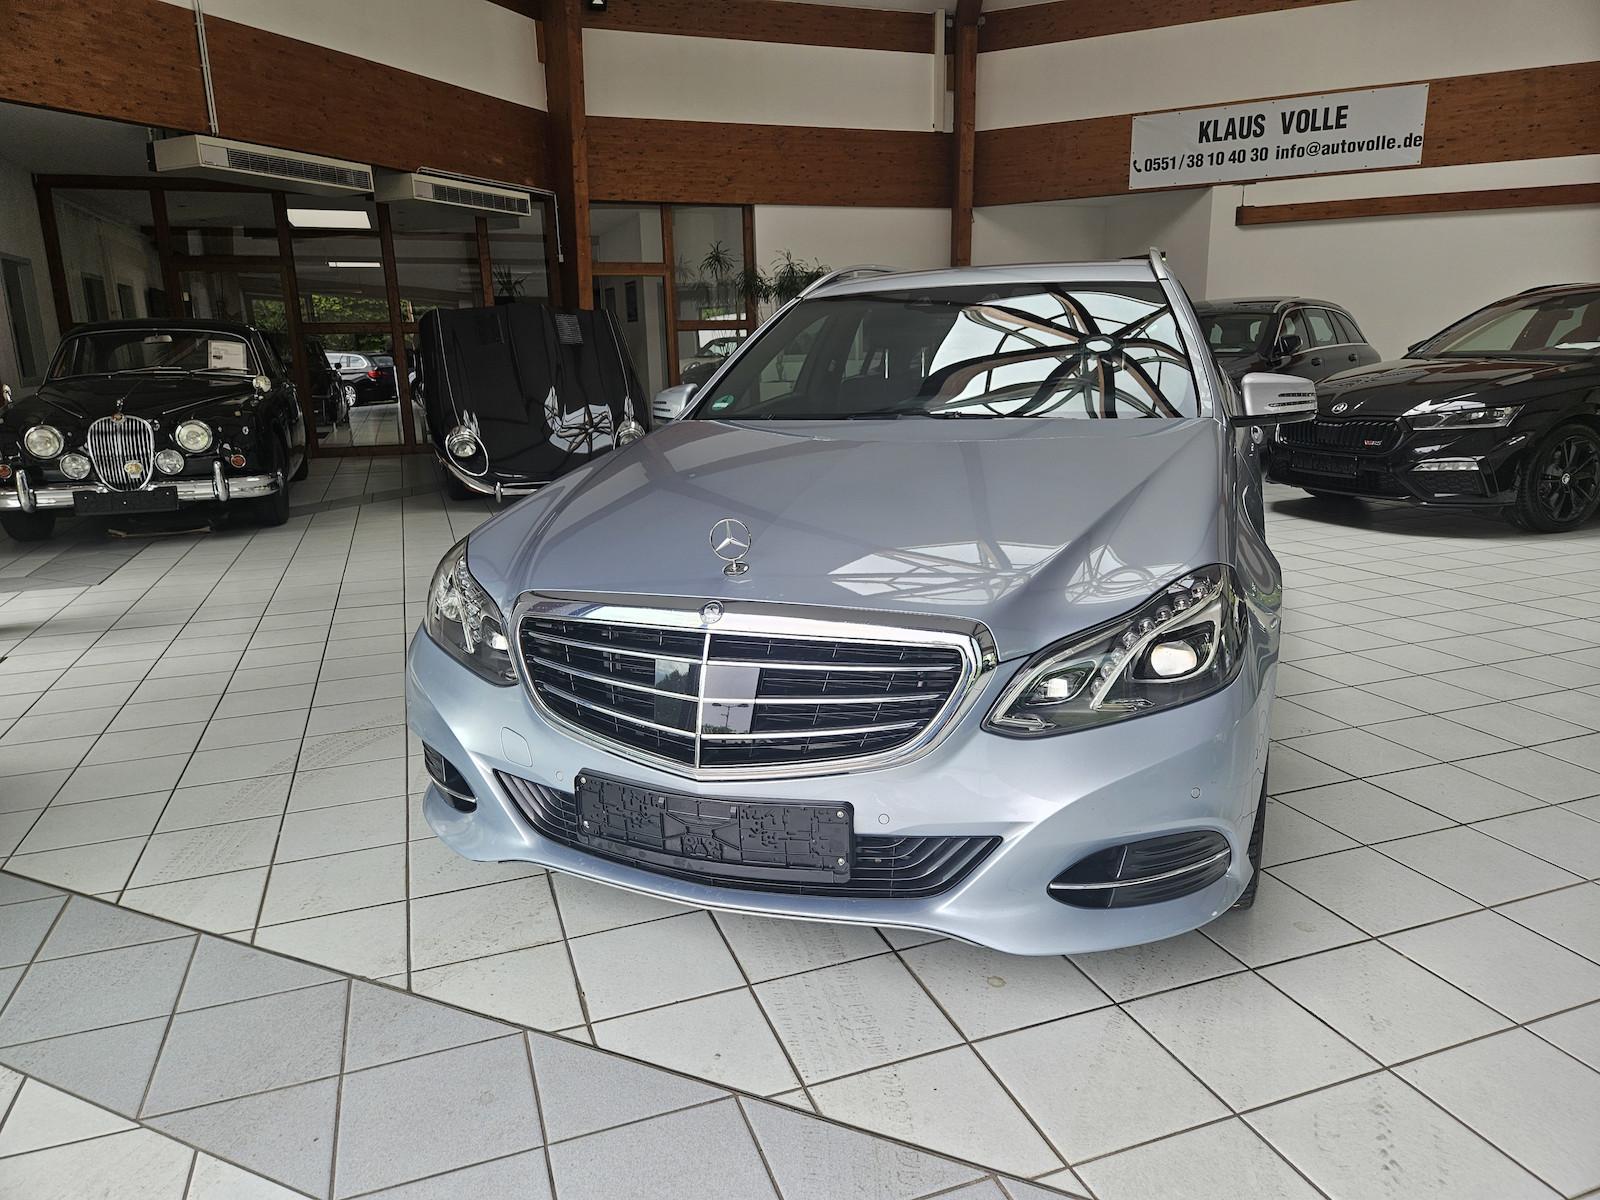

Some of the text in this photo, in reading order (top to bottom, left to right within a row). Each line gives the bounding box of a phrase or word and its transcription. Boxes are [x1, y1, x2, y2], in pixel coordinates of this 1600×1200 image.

[1198, 105, 1349, 144] KLAUS VOLLE
[1208, 151, 1225, 166] 10
[1228, 149, 1246, 164] 40
[1250, 147, 1269, 162] 30
[1275, 133, 1423, 160] info@autovolle.de
